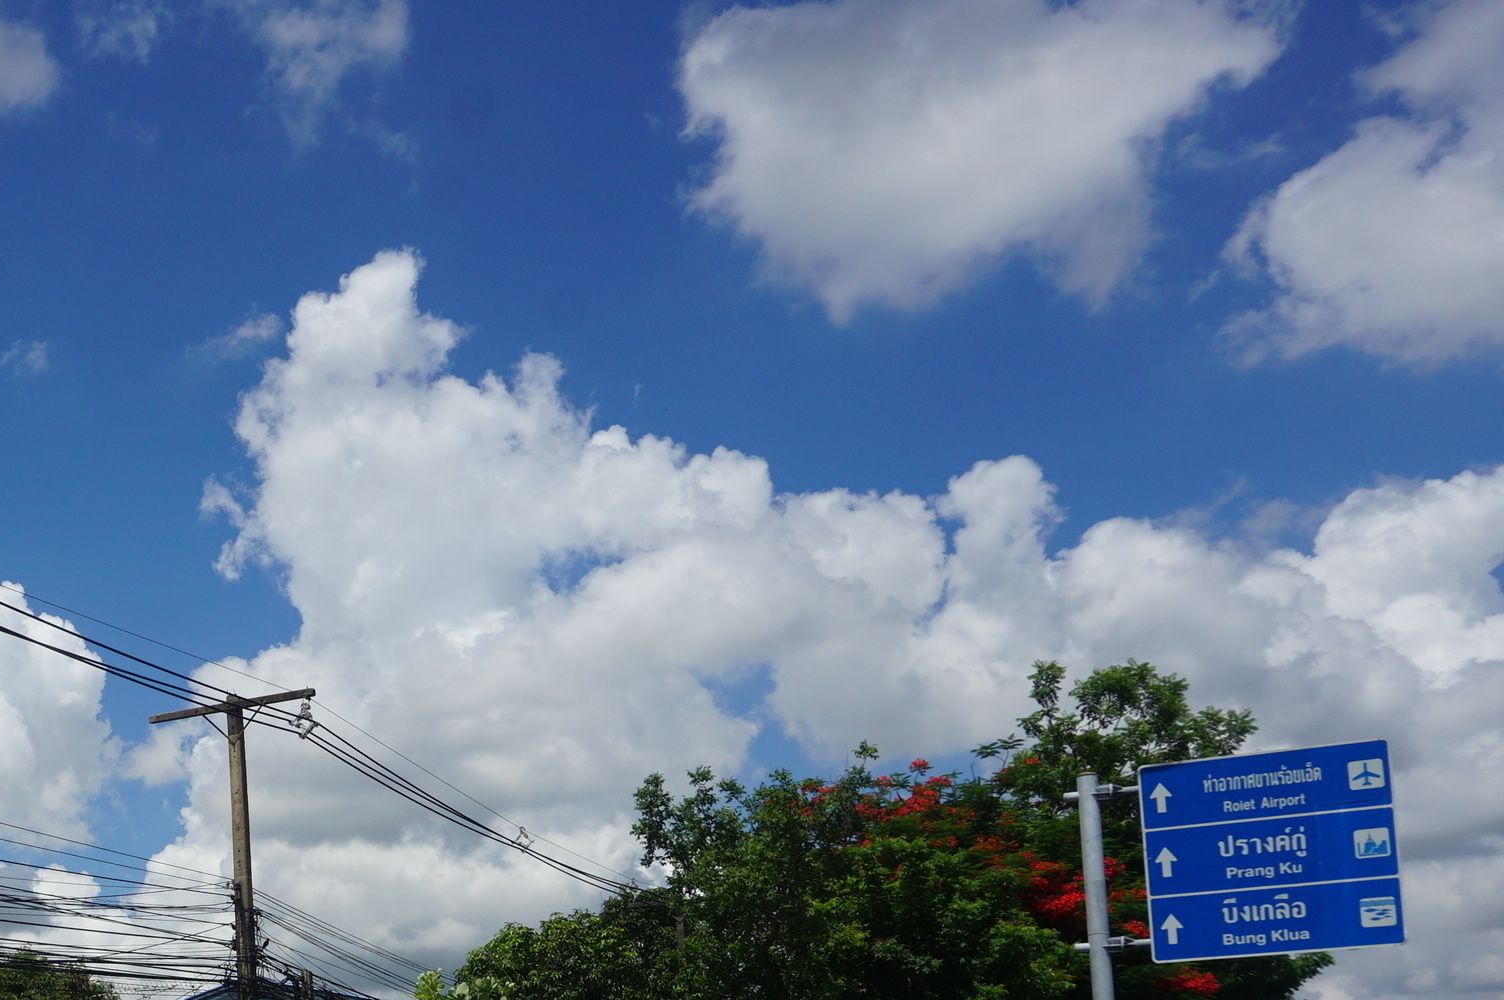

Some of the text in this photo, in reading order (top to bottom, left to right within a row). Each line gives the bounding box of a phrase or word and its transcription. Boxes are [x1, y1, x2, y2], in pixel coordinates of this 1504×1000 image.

[1202, 762, 1322, 793] ท่าอากาศยานร้อยเอ็ด
[1223, 793, 1306, 813] Roiet Airport
[1218, 826, 1307, 858] ปรางค์กู่
[1226, 862, 1303, 879] Prang Ku
[1222, 893, 1307, 924] บึงเกลือ
[1222, 929, 1310, 946] Bung Klua
